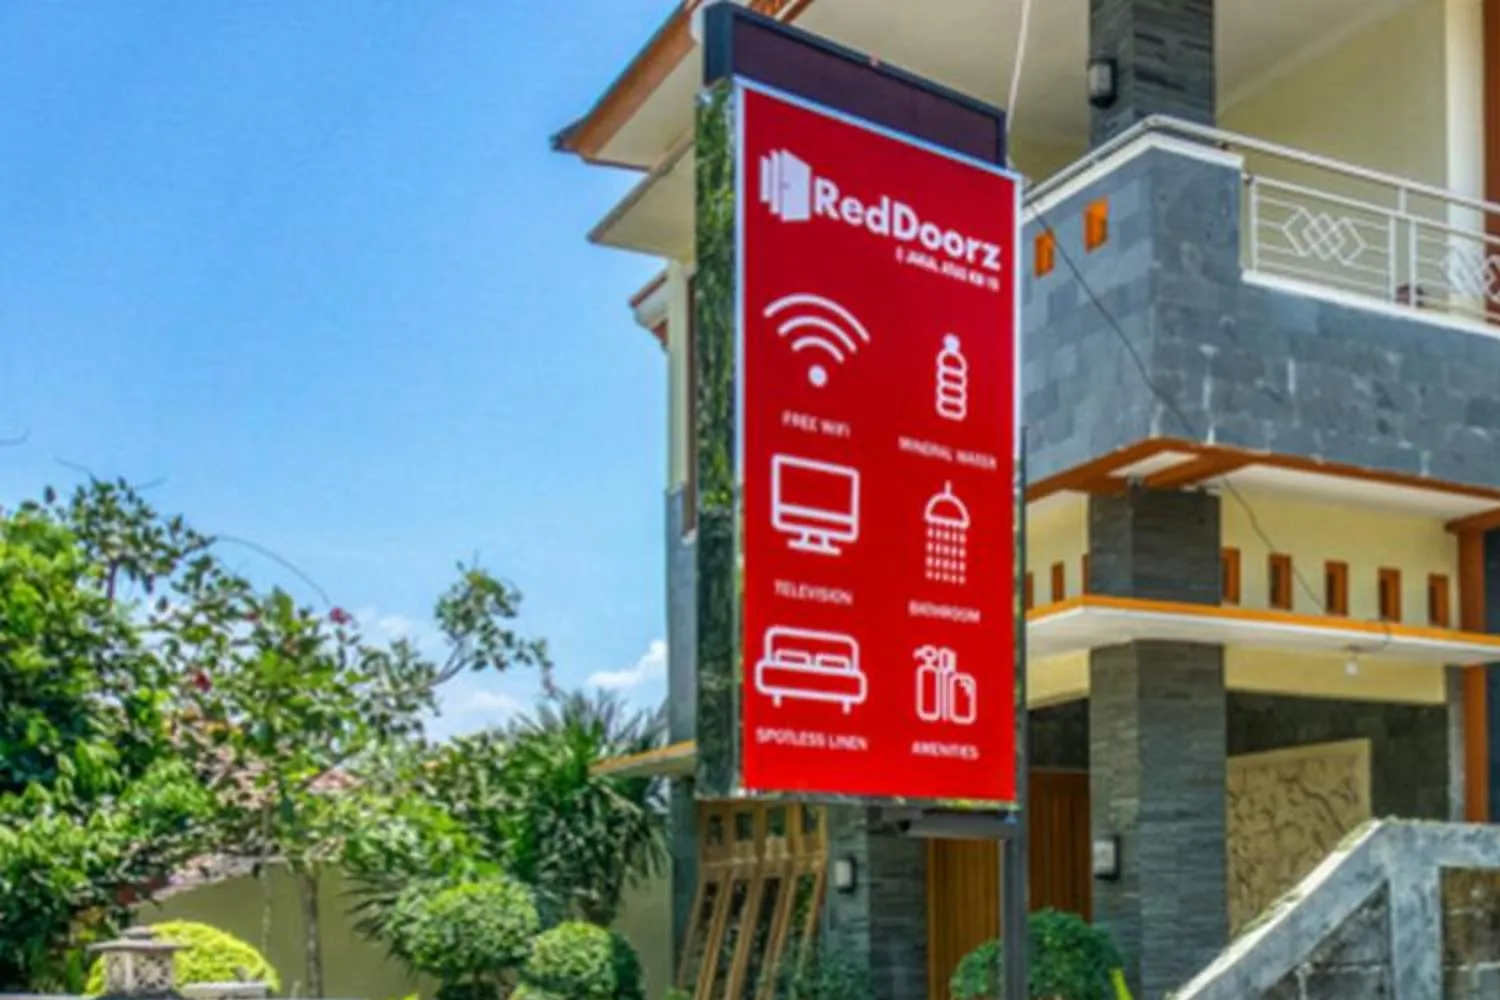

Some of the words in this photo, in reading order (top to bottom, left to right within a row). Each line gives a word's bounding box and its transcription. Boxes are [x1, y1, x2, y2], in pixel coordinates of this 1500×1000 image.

[813, 176, 1001, 271] RedDoorz
[782, 410, 817, 431] FREE
[955, 450, 997, 469] WATER
[774, 579, 853, 606] TELEVISION
[908, 600, 981, 623] BATHROOM
[756, 727, 826, 748] SPOTLESS
[828, 735, 868, 751] LINEN
